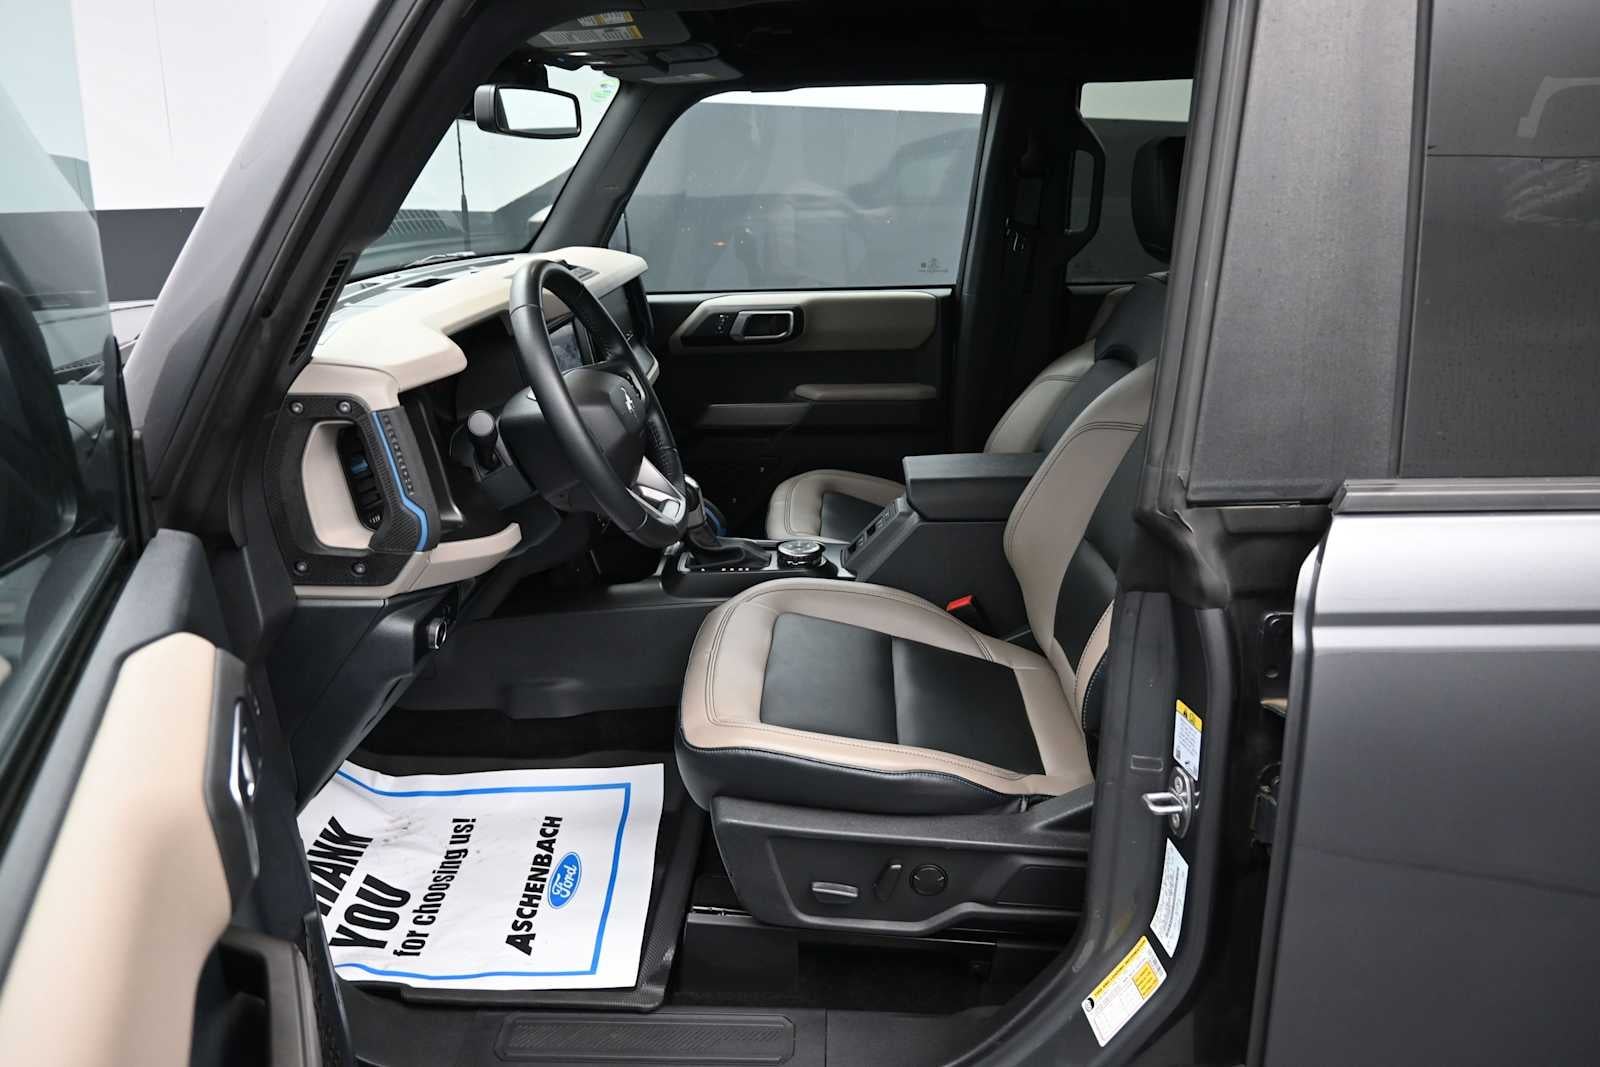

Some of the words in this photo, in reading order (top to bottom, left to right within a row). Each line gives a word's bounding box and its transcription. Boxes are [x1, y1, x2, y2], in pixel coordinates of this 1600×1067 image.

[307, 816, 374, 916] ANK
[327, 873, 411, 951] YOU
[393, 930, 429, 957] for
[412, 848, 469, 926] choosing
[449, 817, 477, 845] us!
[505, 815, 563, 956] ASCHENBACH
[551, 864, 578, 899] Ford
